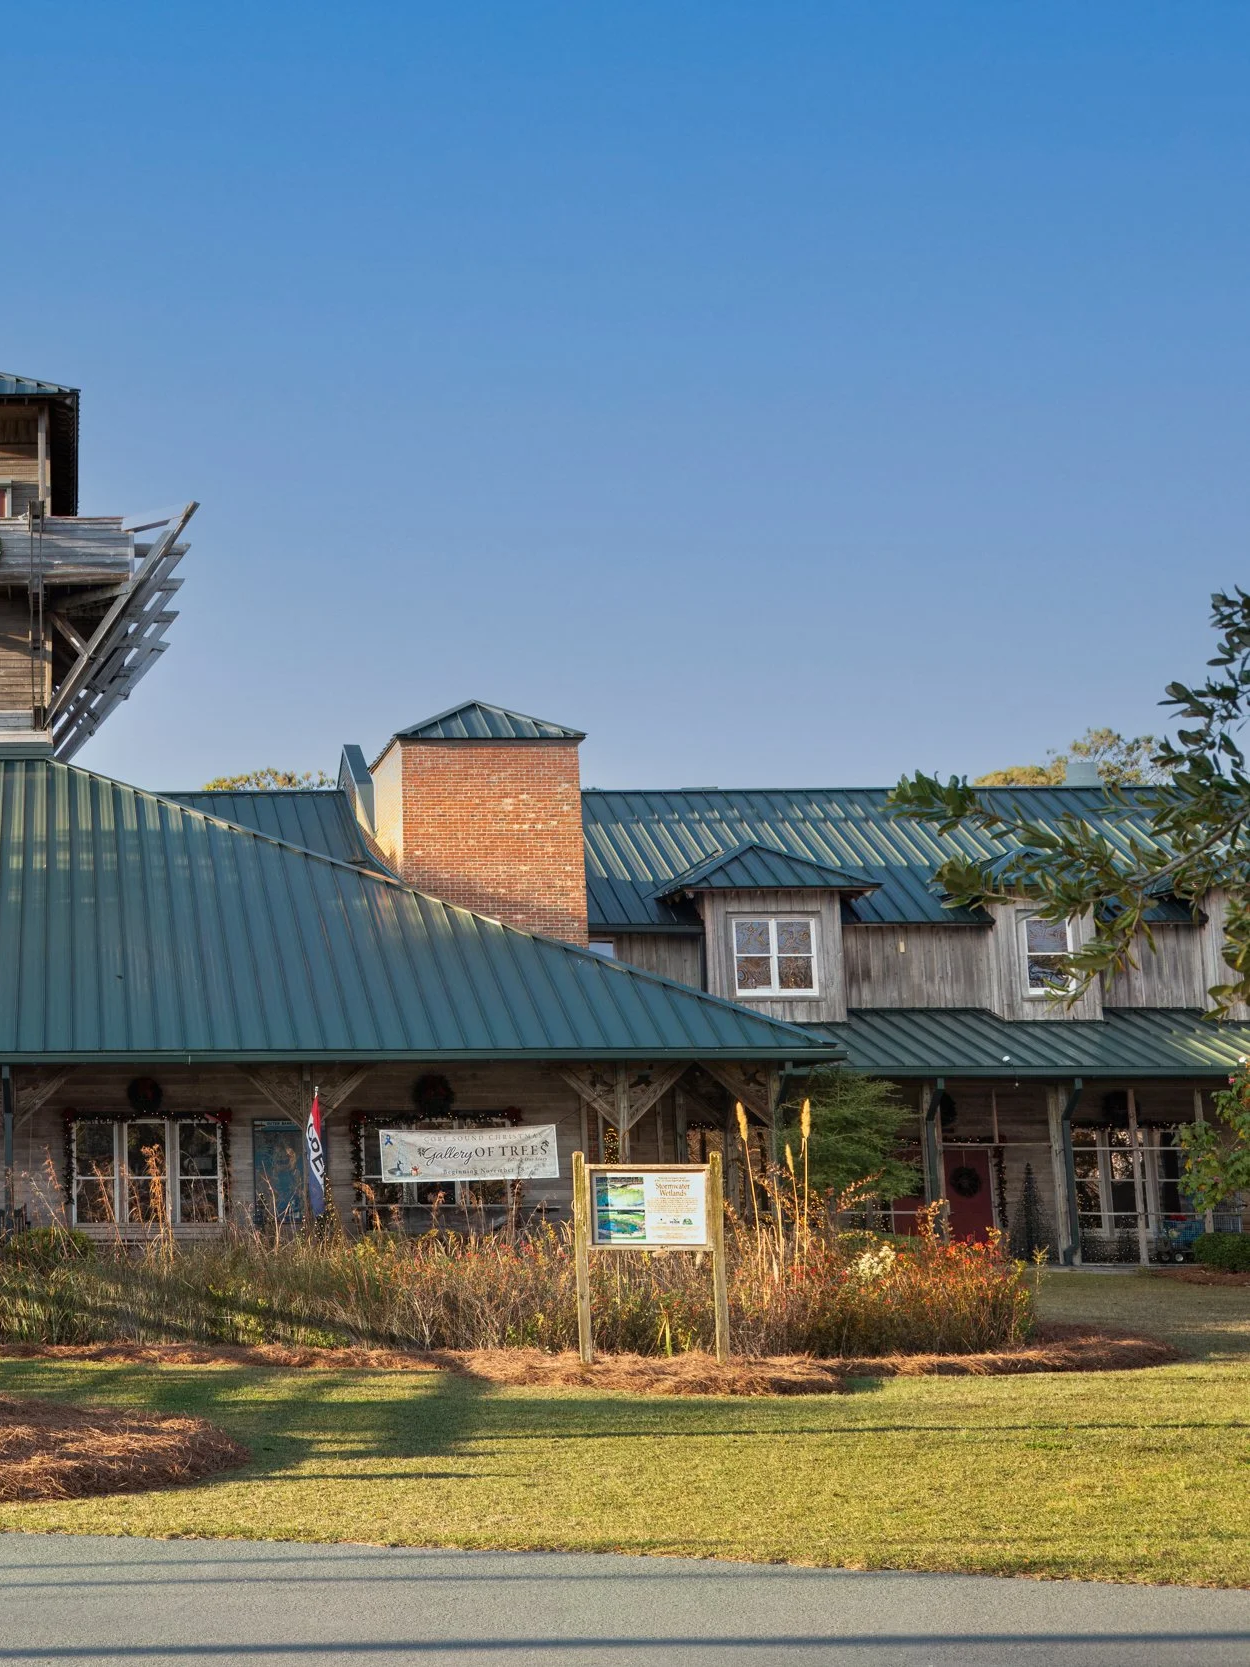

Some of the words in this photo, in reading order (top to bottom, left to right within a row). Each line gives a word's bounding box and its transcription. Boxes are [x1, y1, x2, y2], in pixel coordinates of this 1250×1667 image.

[452, 1134, 484, 1142] SOUND
[488, 1132, 543, 1141] CHRISTMAS
[423, 1146, 473, 1166] Gallery
[475, 1146, 494, 1158] OF
[498, 1145, 547, 1157] TREES
